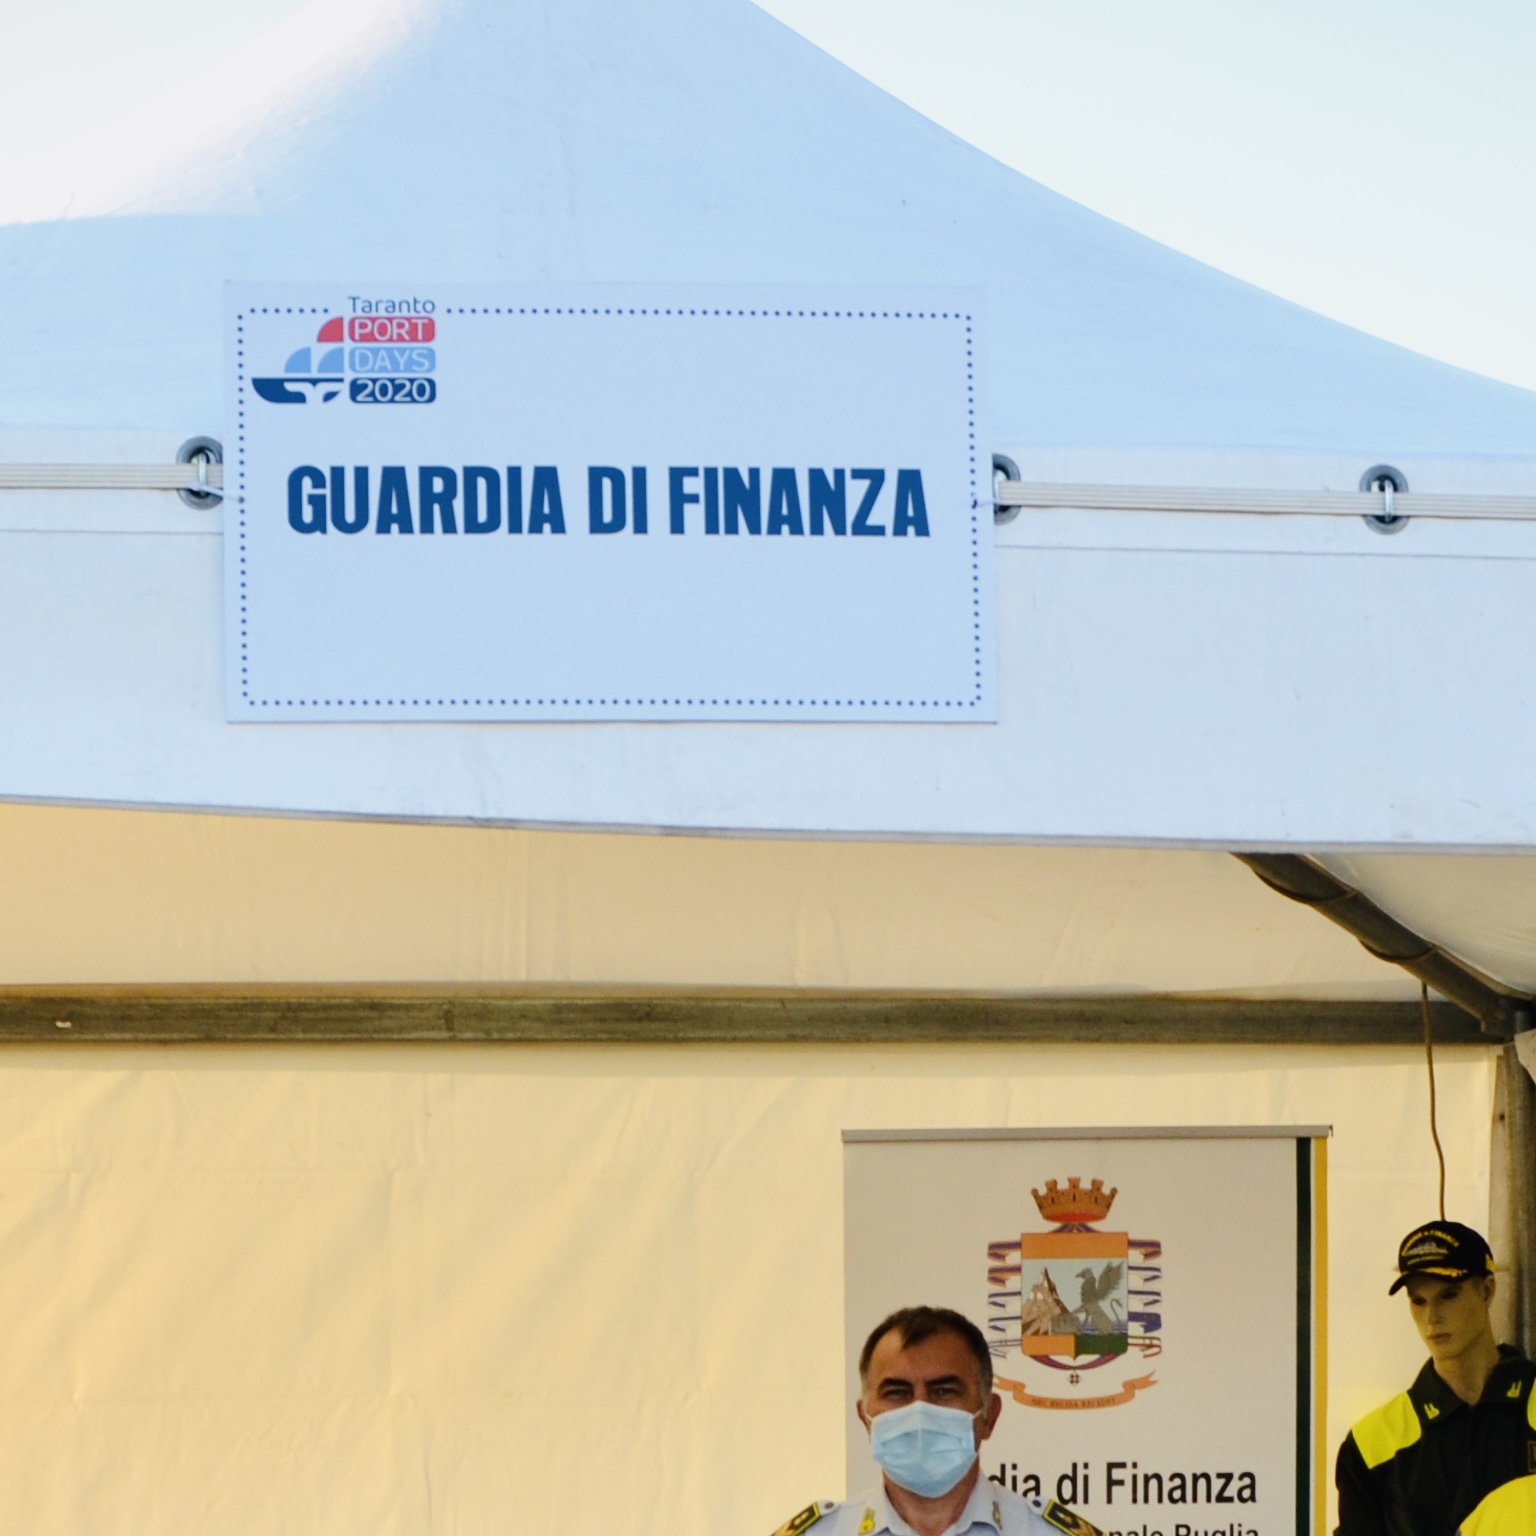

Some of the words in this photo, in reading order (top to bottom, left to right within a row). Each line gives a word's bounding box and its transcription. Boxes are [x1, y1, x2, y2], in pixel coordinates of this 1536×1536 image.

[348, 296, 435, 314] Taranto
[353, 318, 430, 341] PORT
[354, 348, 430, 372] DAYS
[355, 378, 431, 402] 2020
[286, 464, 568, 535] GUARDIA
[587, 465, 649, 536] DI
[669, 466, 932, 537] FINANZA
[1056, 1461, 1090, 1505] di
[1105, 1461, 1258, 1505] Finanza
